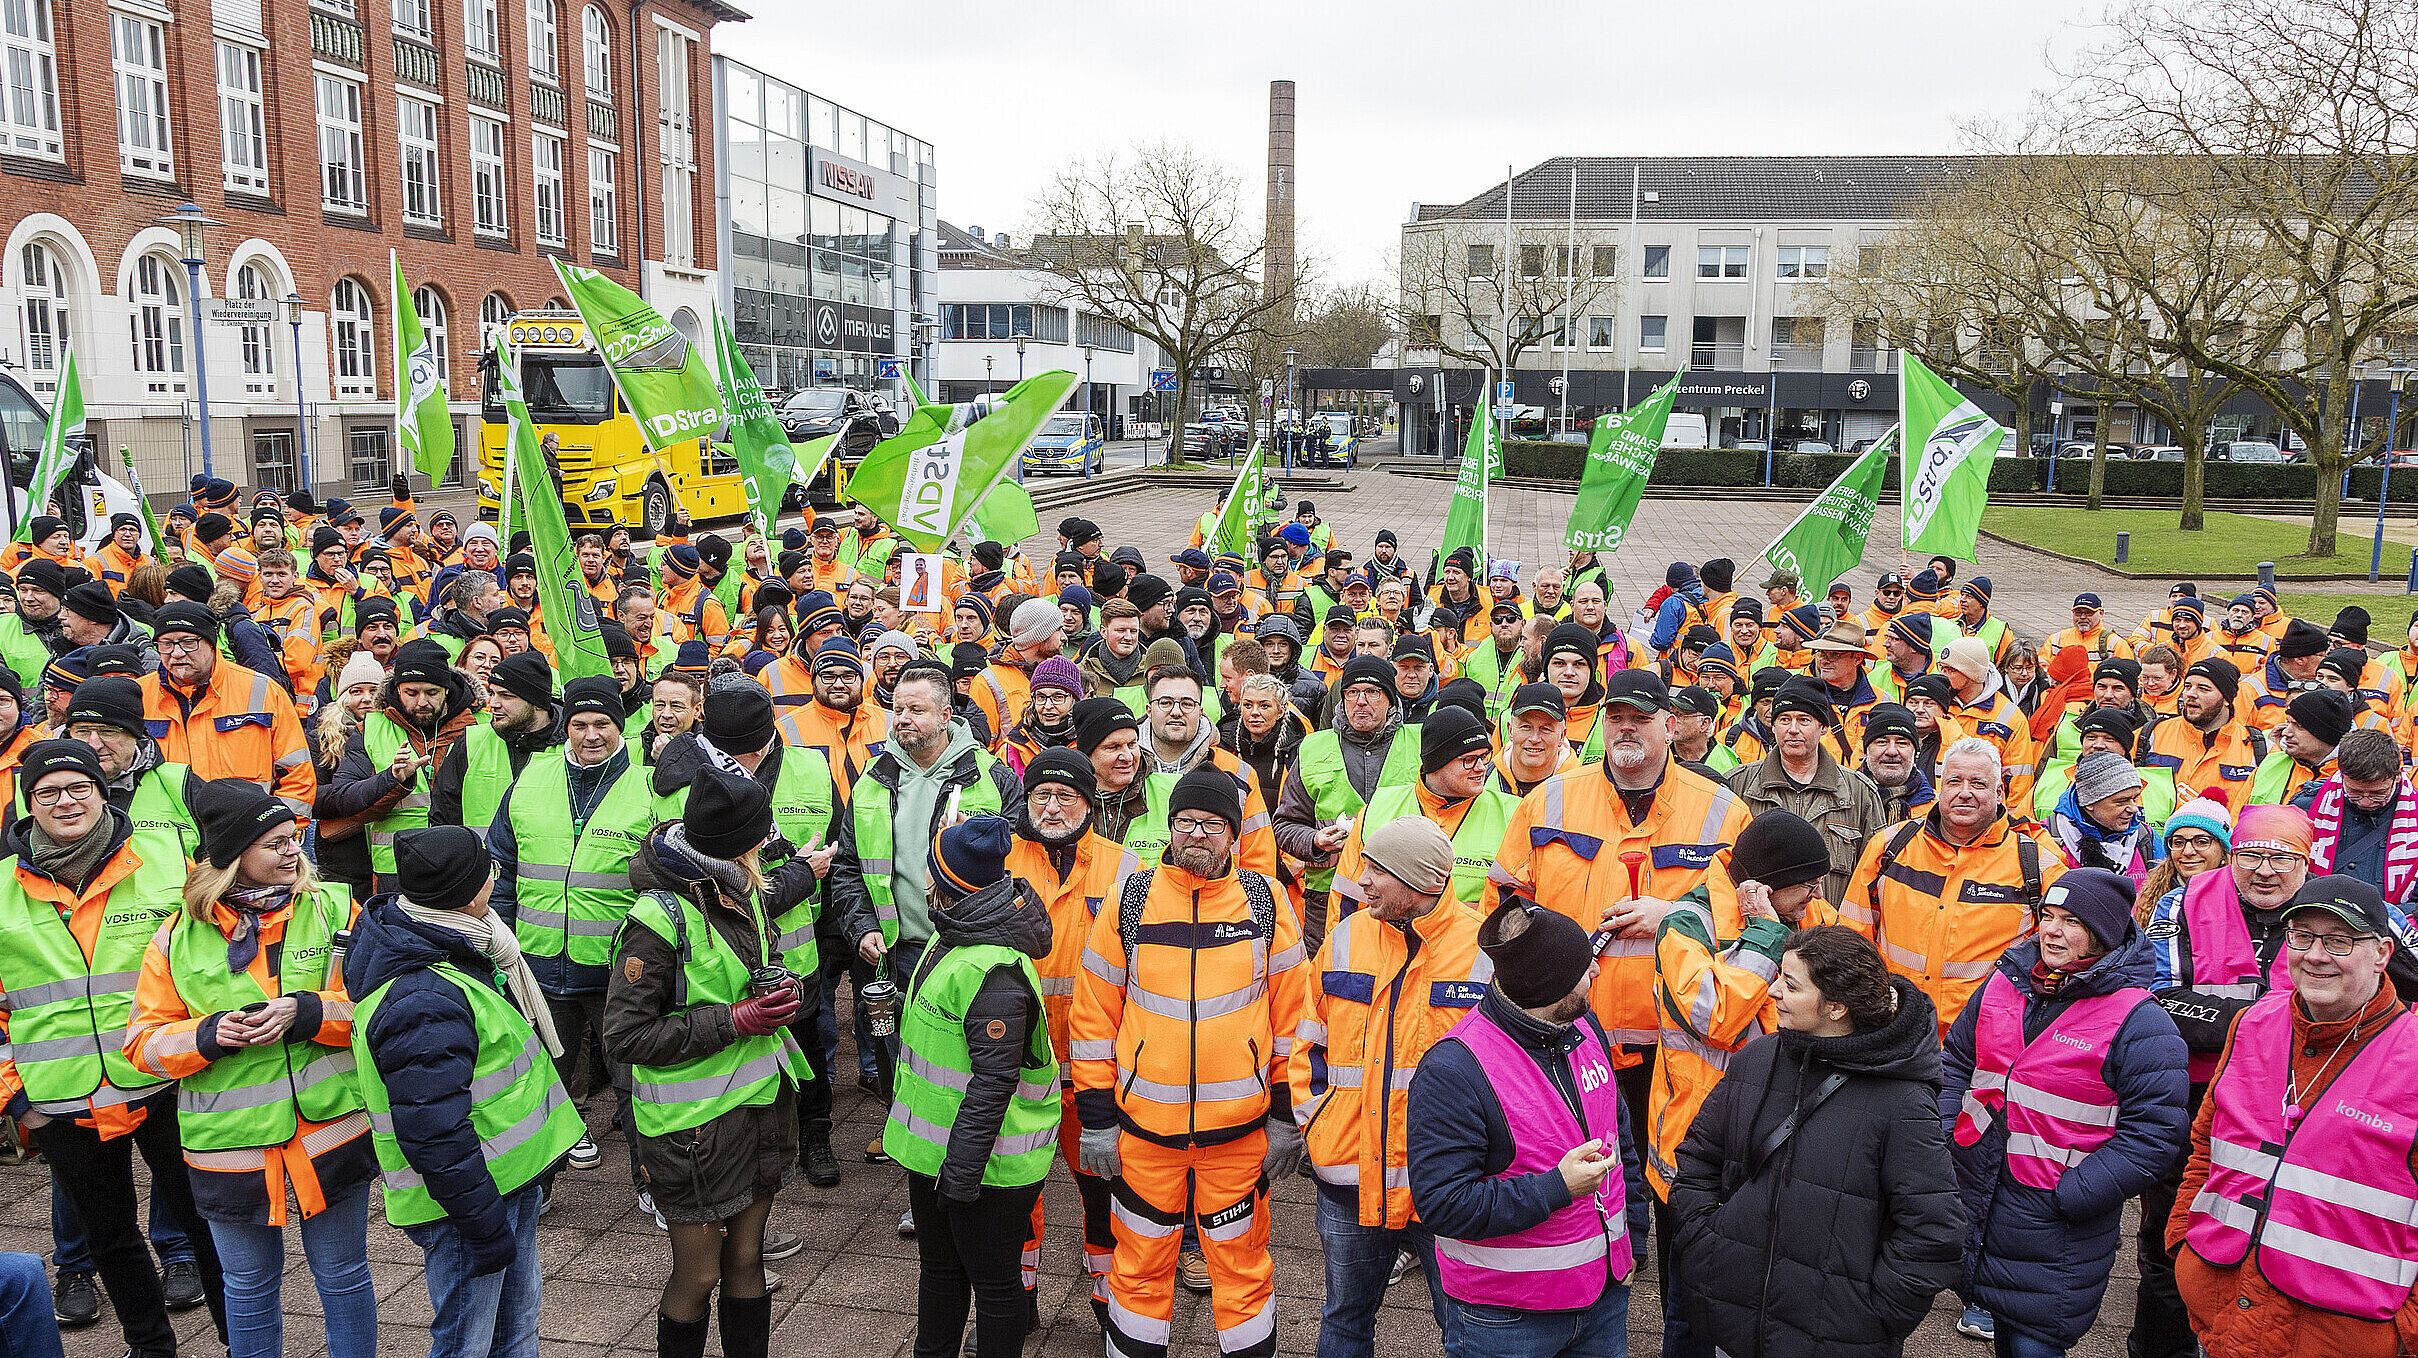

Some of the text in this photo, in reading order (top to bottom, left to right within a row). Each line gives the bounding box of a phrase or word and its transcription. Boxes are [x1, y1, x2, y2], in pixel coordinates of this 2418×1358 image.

[822, 160, 875, 200] NISSAN
[224, 300, 256, 309] Platz der
[211, 310, 272, 320] Wiedervereinigung
[844, 319, 891, 340] MAXUS
[1651, 383, 1765, 395] Azentrum Preckel
[2112, 418, 2131, 426] Jeep
[132, 820, 169, 829] VDStra.
[590, 828, 625, 840] VDStra.
[2237, 838, 2291, 853] komba
[104, 911, 151, 925] VDStra.
[2051, 1029, 2094, 1052] komba
[2334, 1100, 2394, 1134] komba
[1212, 1201, 1251, 1227] STIHL
